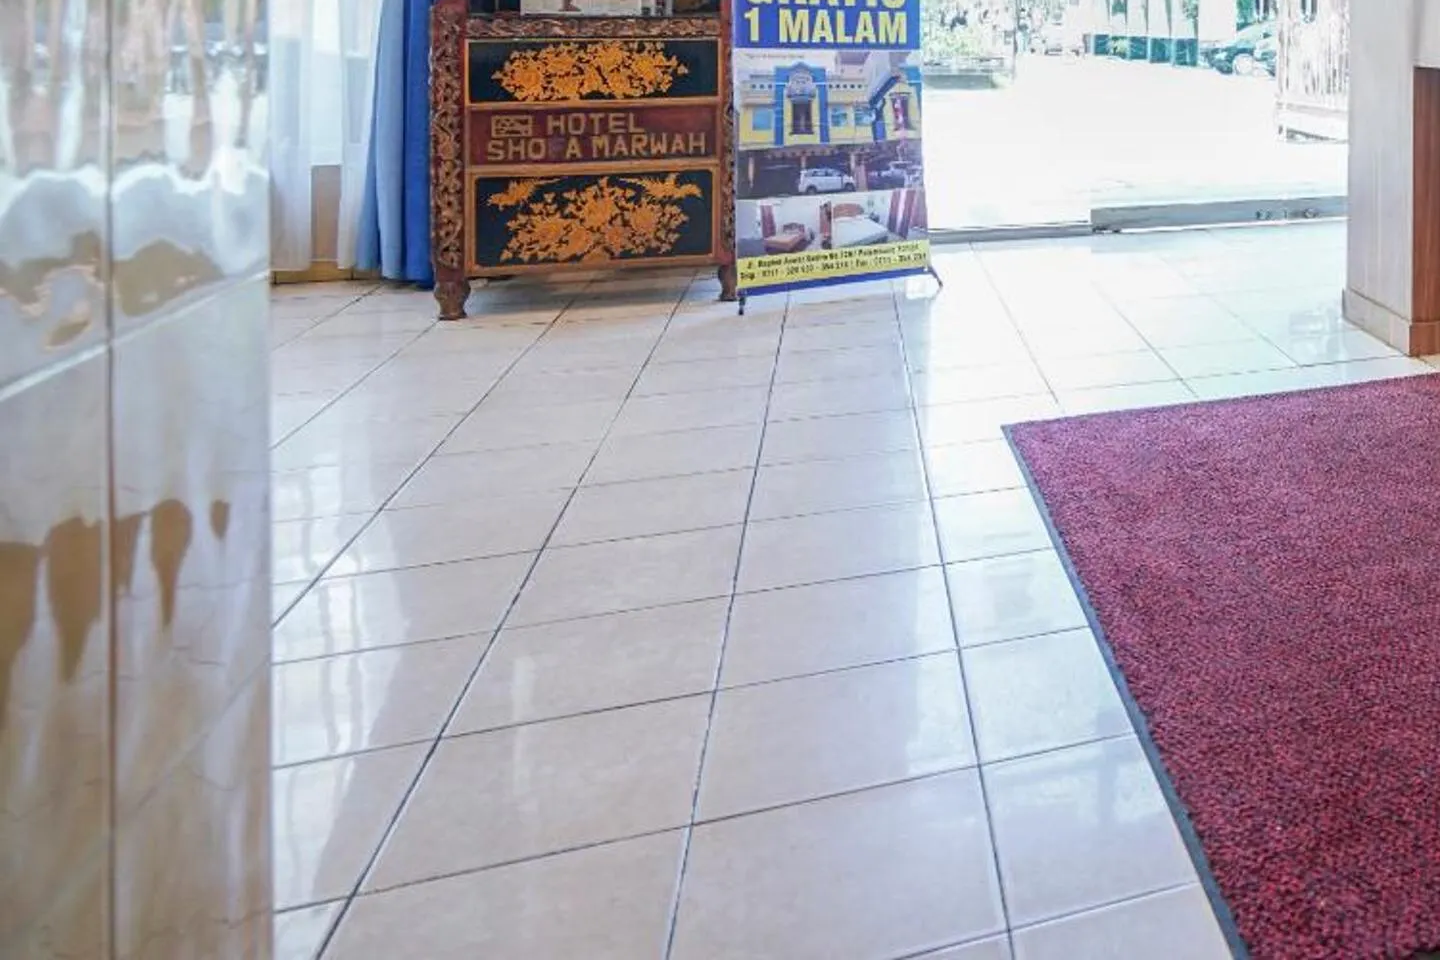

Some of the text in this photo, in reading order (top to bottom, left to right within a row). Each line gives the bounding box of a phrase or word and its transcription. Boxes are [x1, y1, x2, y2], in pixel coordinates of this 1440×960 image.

[743, 7, 907, 44] 1 MALAM
[547, 112, 646, 136] HOTEL
[592, 132, 706, 158] MARWAH
